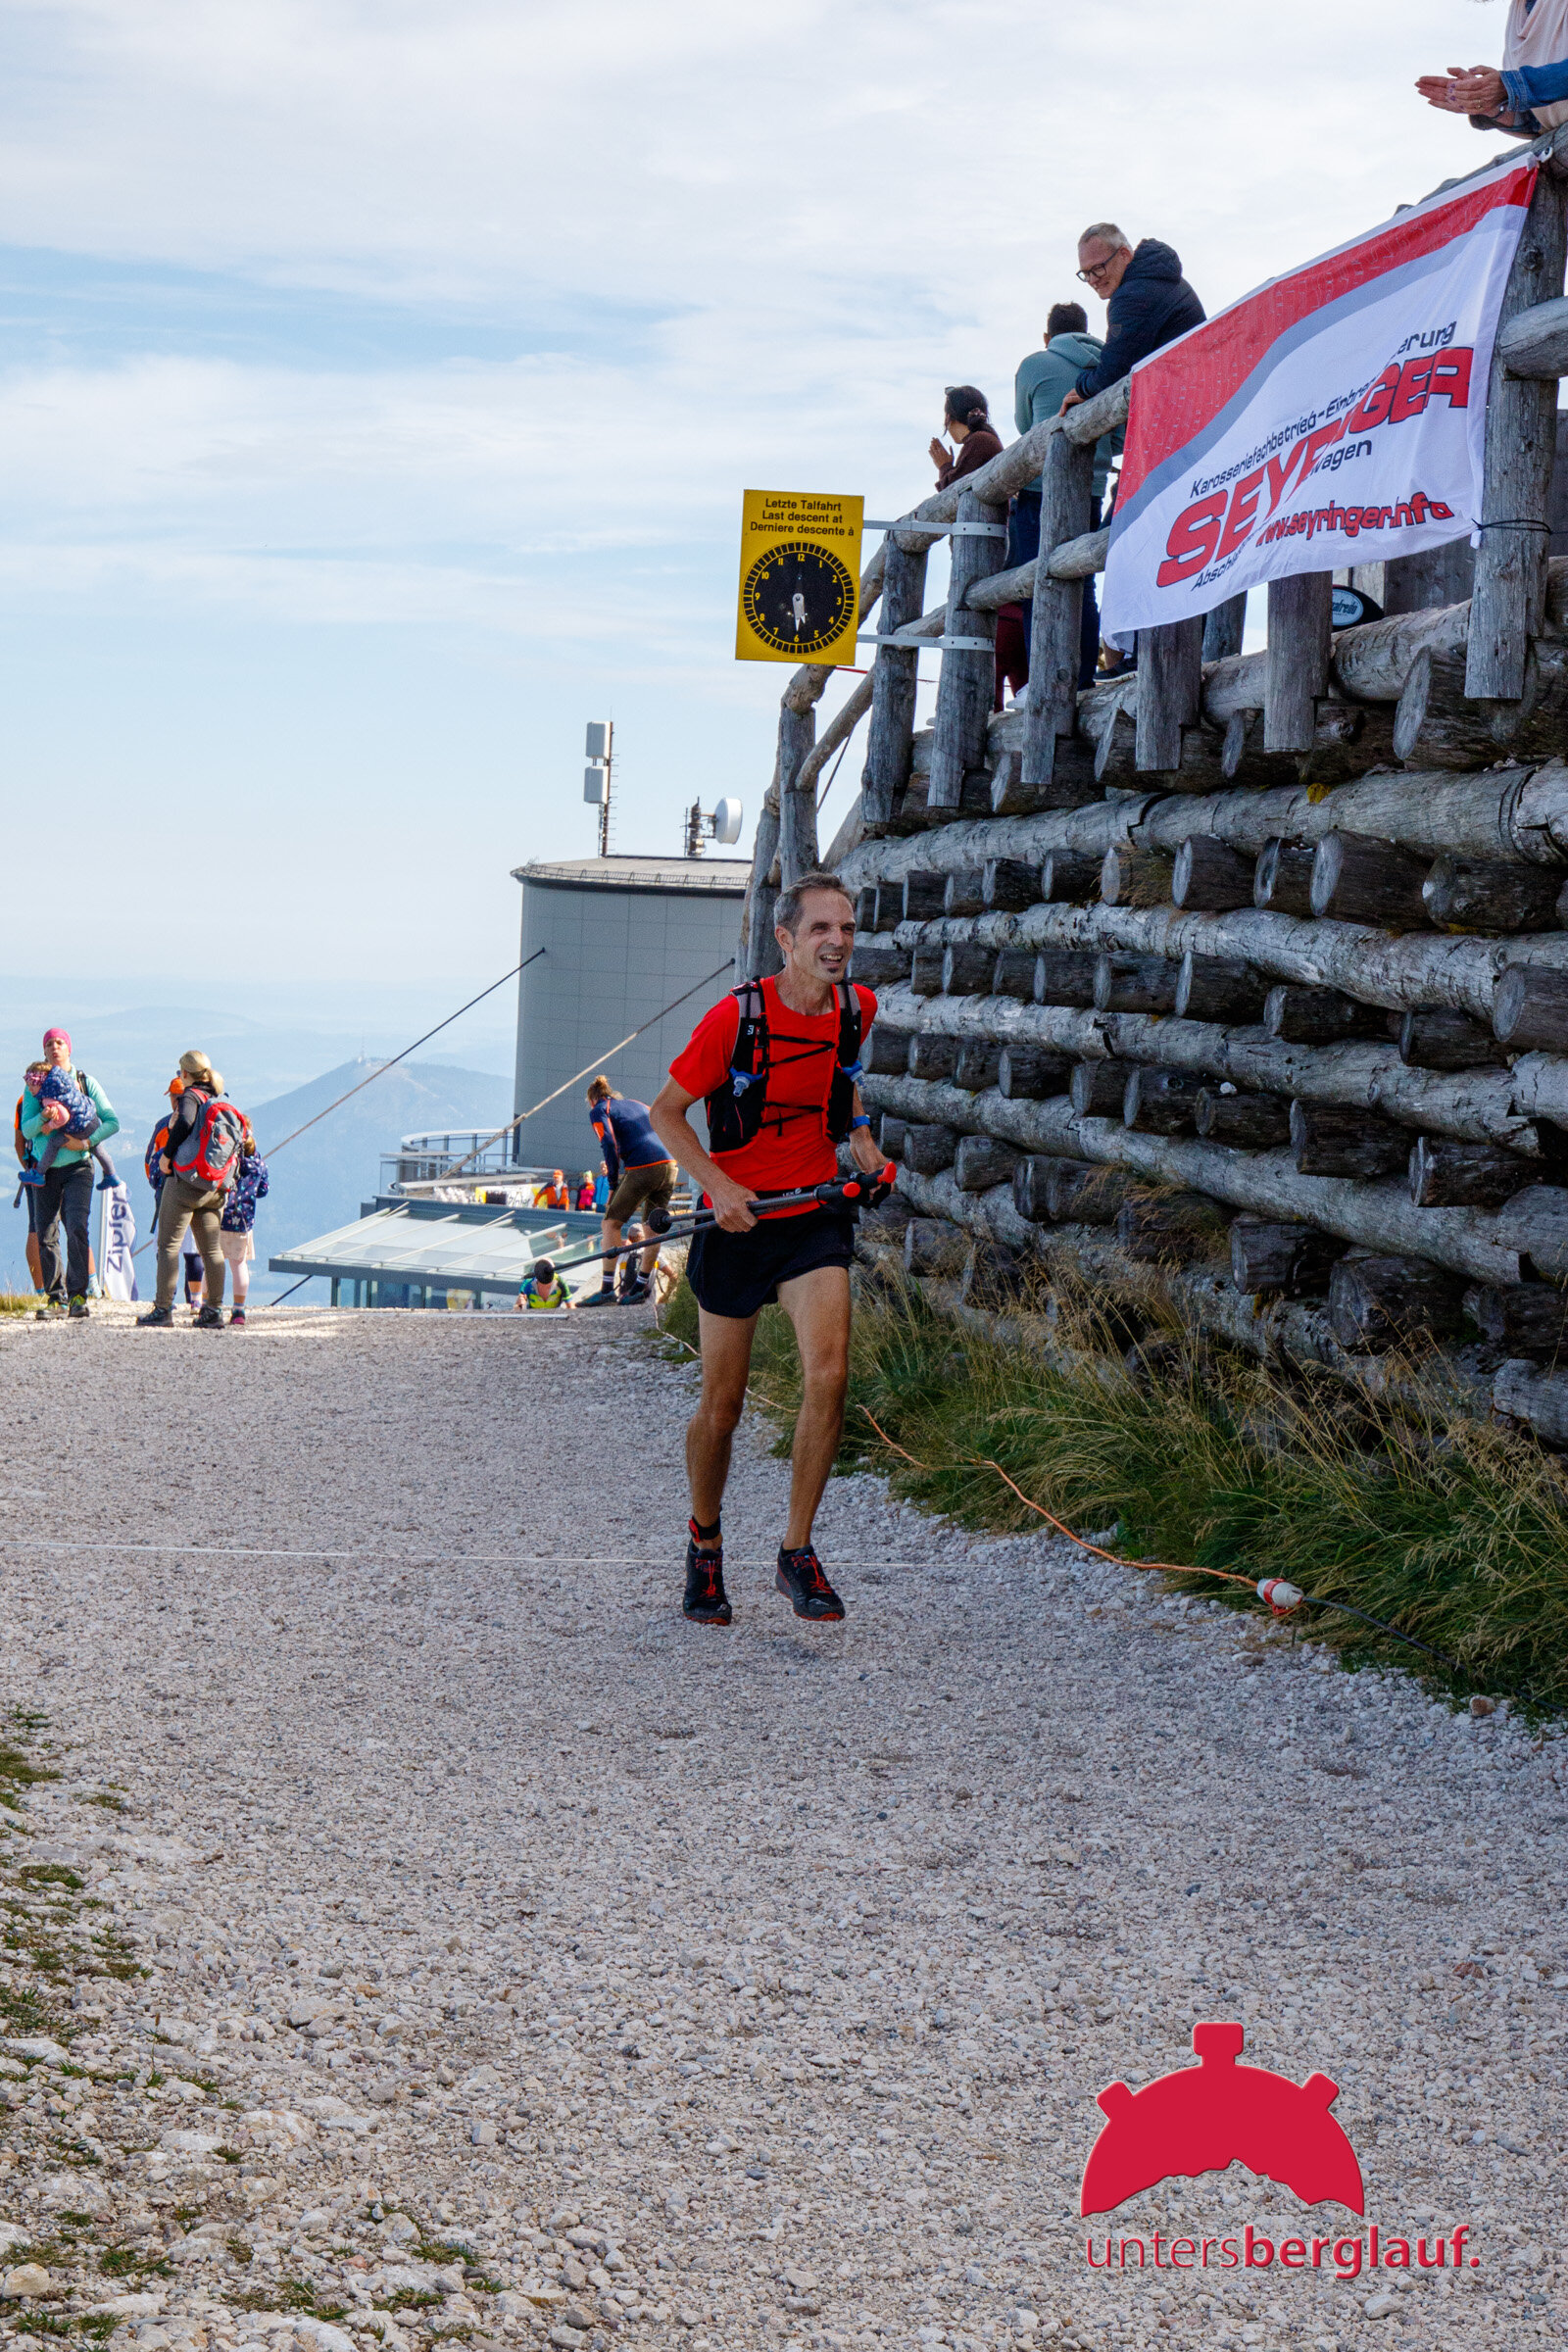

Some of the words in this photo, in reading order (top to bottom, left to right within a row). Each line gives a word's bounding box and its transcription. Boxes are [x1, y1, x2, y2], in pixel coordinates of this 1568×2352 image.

[765, 498, 797, 510] Letzte
[801, 500, 842, 512] Talfahrt
[762, 510, 784, 520] Last
[788, 512, 829, 523] descent
[833, 514, 843, 523] at
[750, 521, 794, 533] Derniere
[797, 524, 845, 536] descente
[777, 558, 784, 566] 11
[797, 553, 806, 562] 12
[818, 560, 823, 568] 1
[761, 571, 769, 580] 10
[832, 574, 838, 583] 2
[755, 592, 760, 601] 9
[836, 597, 842, 606] 3
[760, 612, 765, 621] 8
[828, 615, 834, 624] 4
[773, 627, 779, 636] 7
[813, 630, 819, 639] 5
[794, 634, 800, 643] 6
